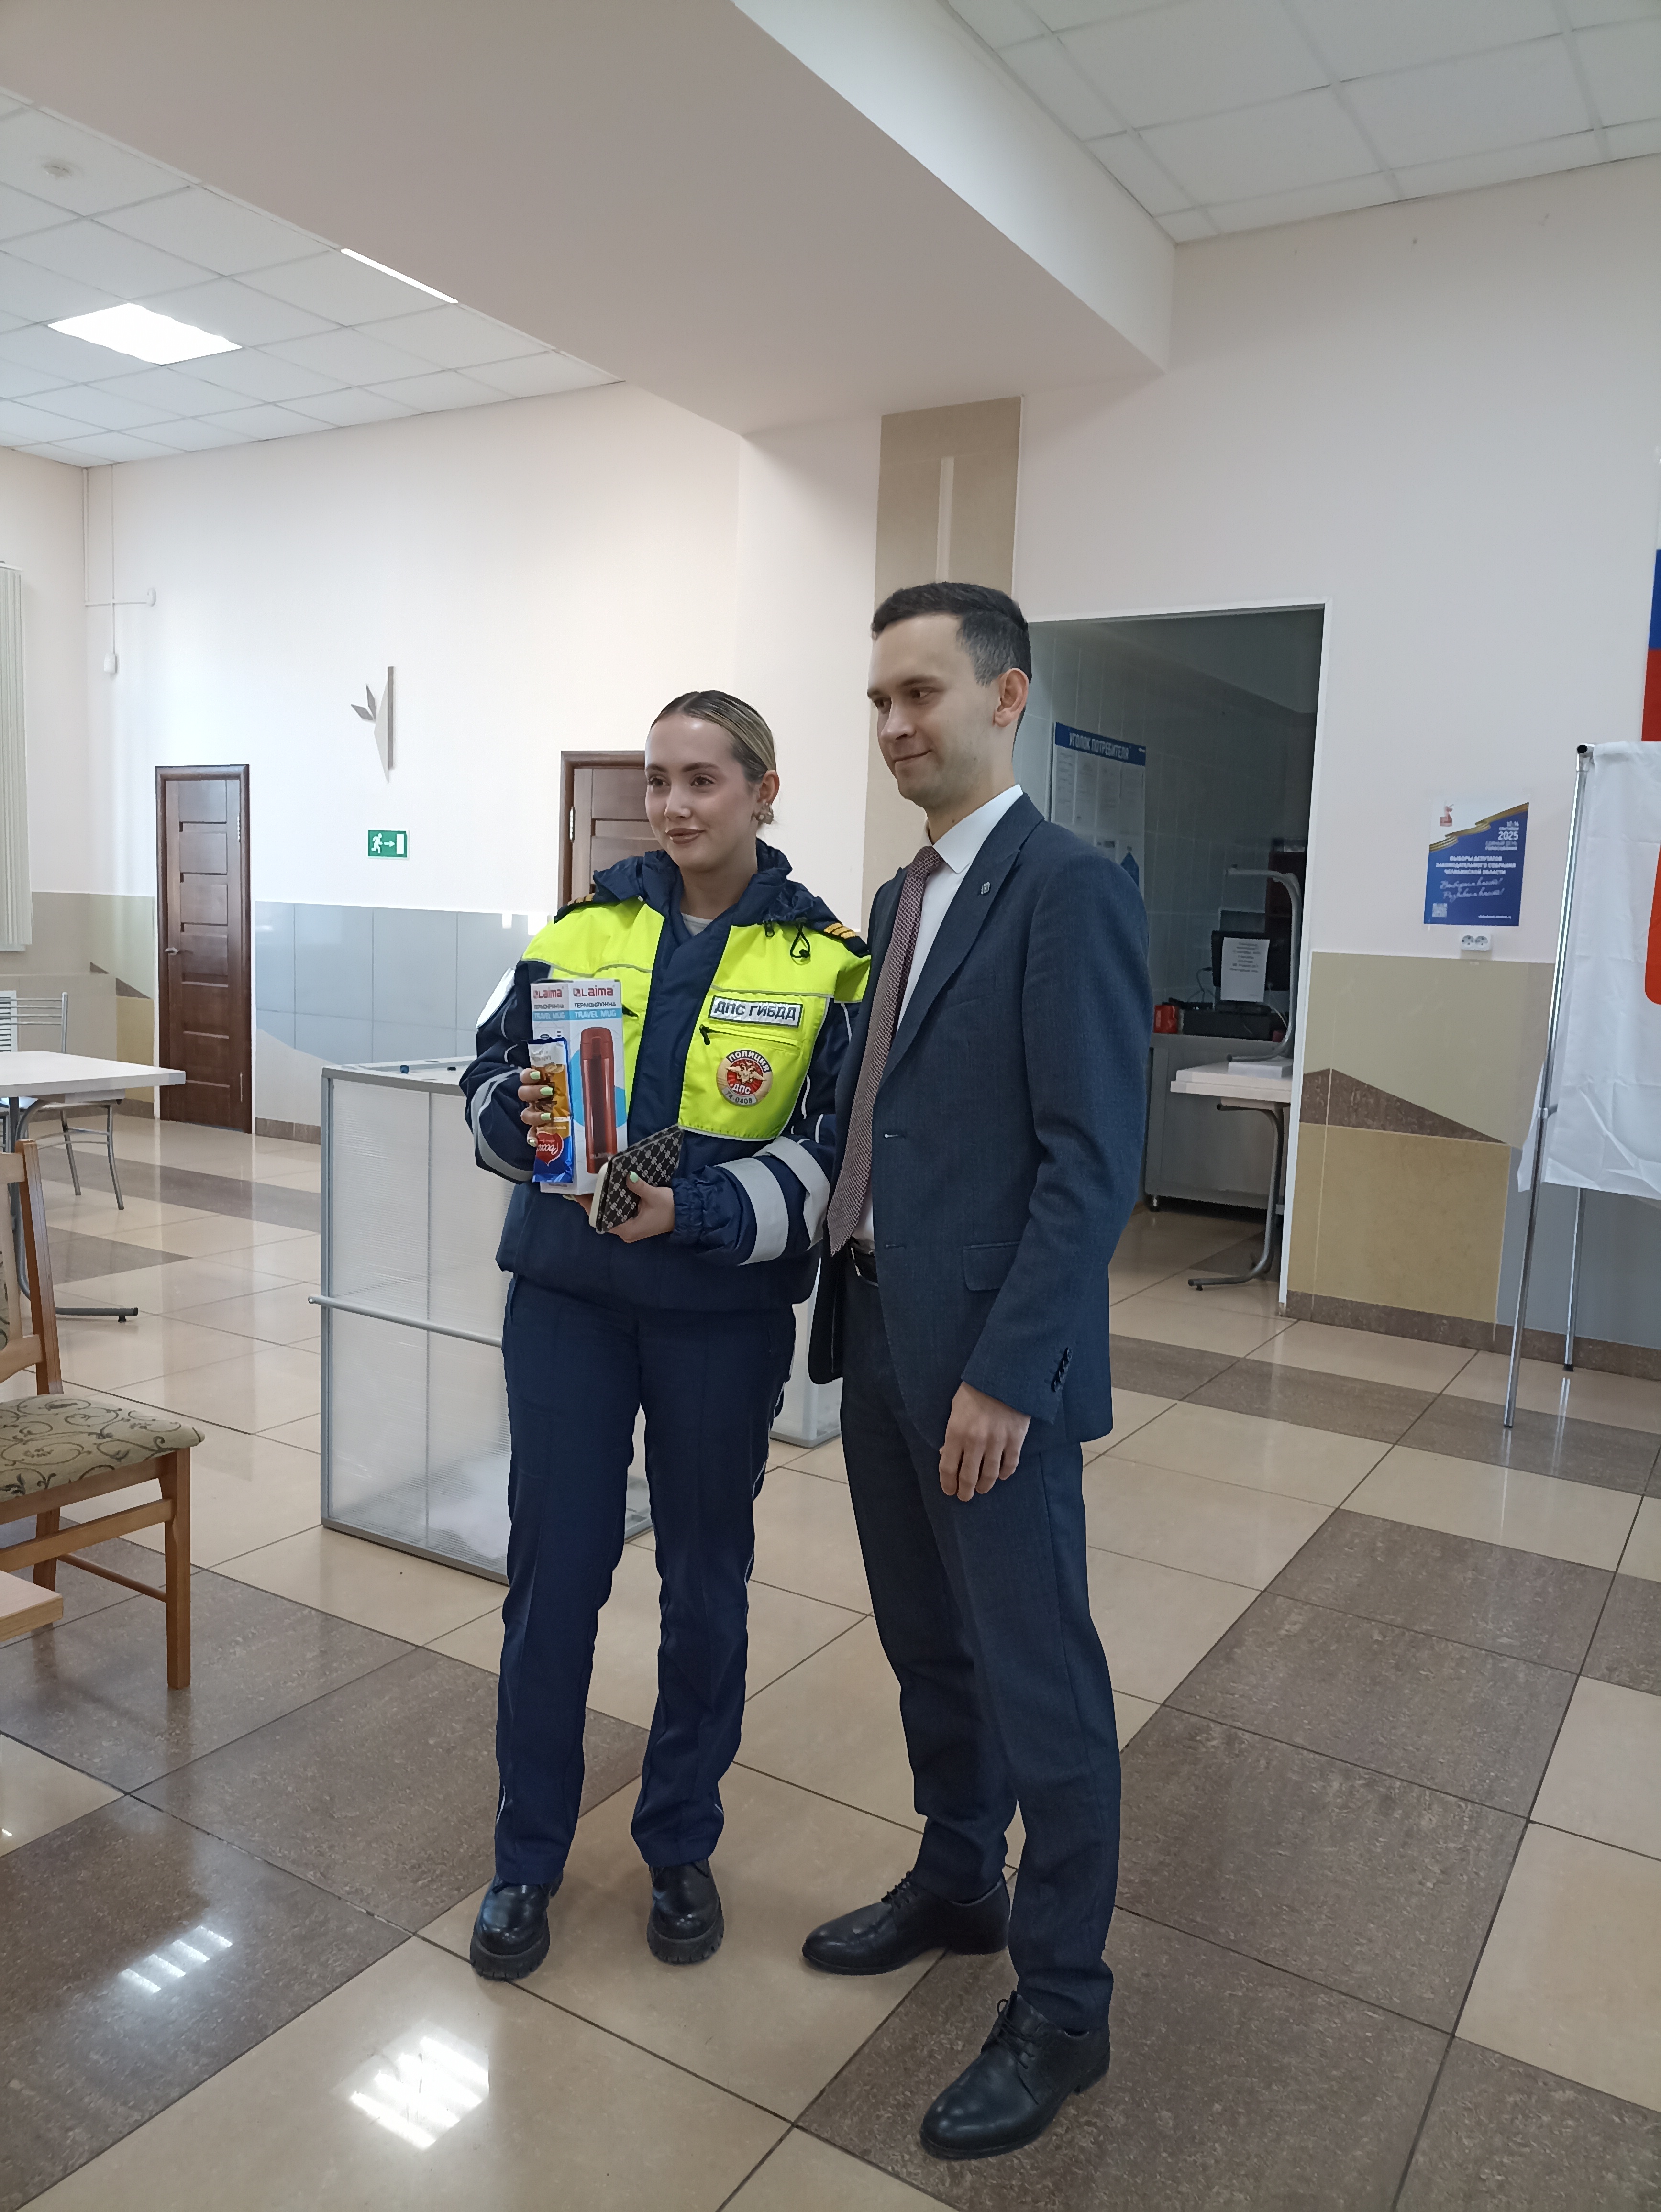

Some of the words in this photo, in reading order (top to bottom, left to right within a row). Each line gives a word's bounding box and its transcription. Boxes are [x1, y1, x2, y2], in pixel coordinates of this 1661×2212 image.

[1498, 831, 1518, 840] 2025
[581, 985, 614, 997] Laima
[714, 1001, 746, 1015] ДПС
[749, 1005, 796, 1021] ГИБДД
[728, 1051, 769, 1071] ПОЛИЦИЯ
[732, 1084, 751, 1095] ДПС
[538, 1142, 559, 1156] Росси
